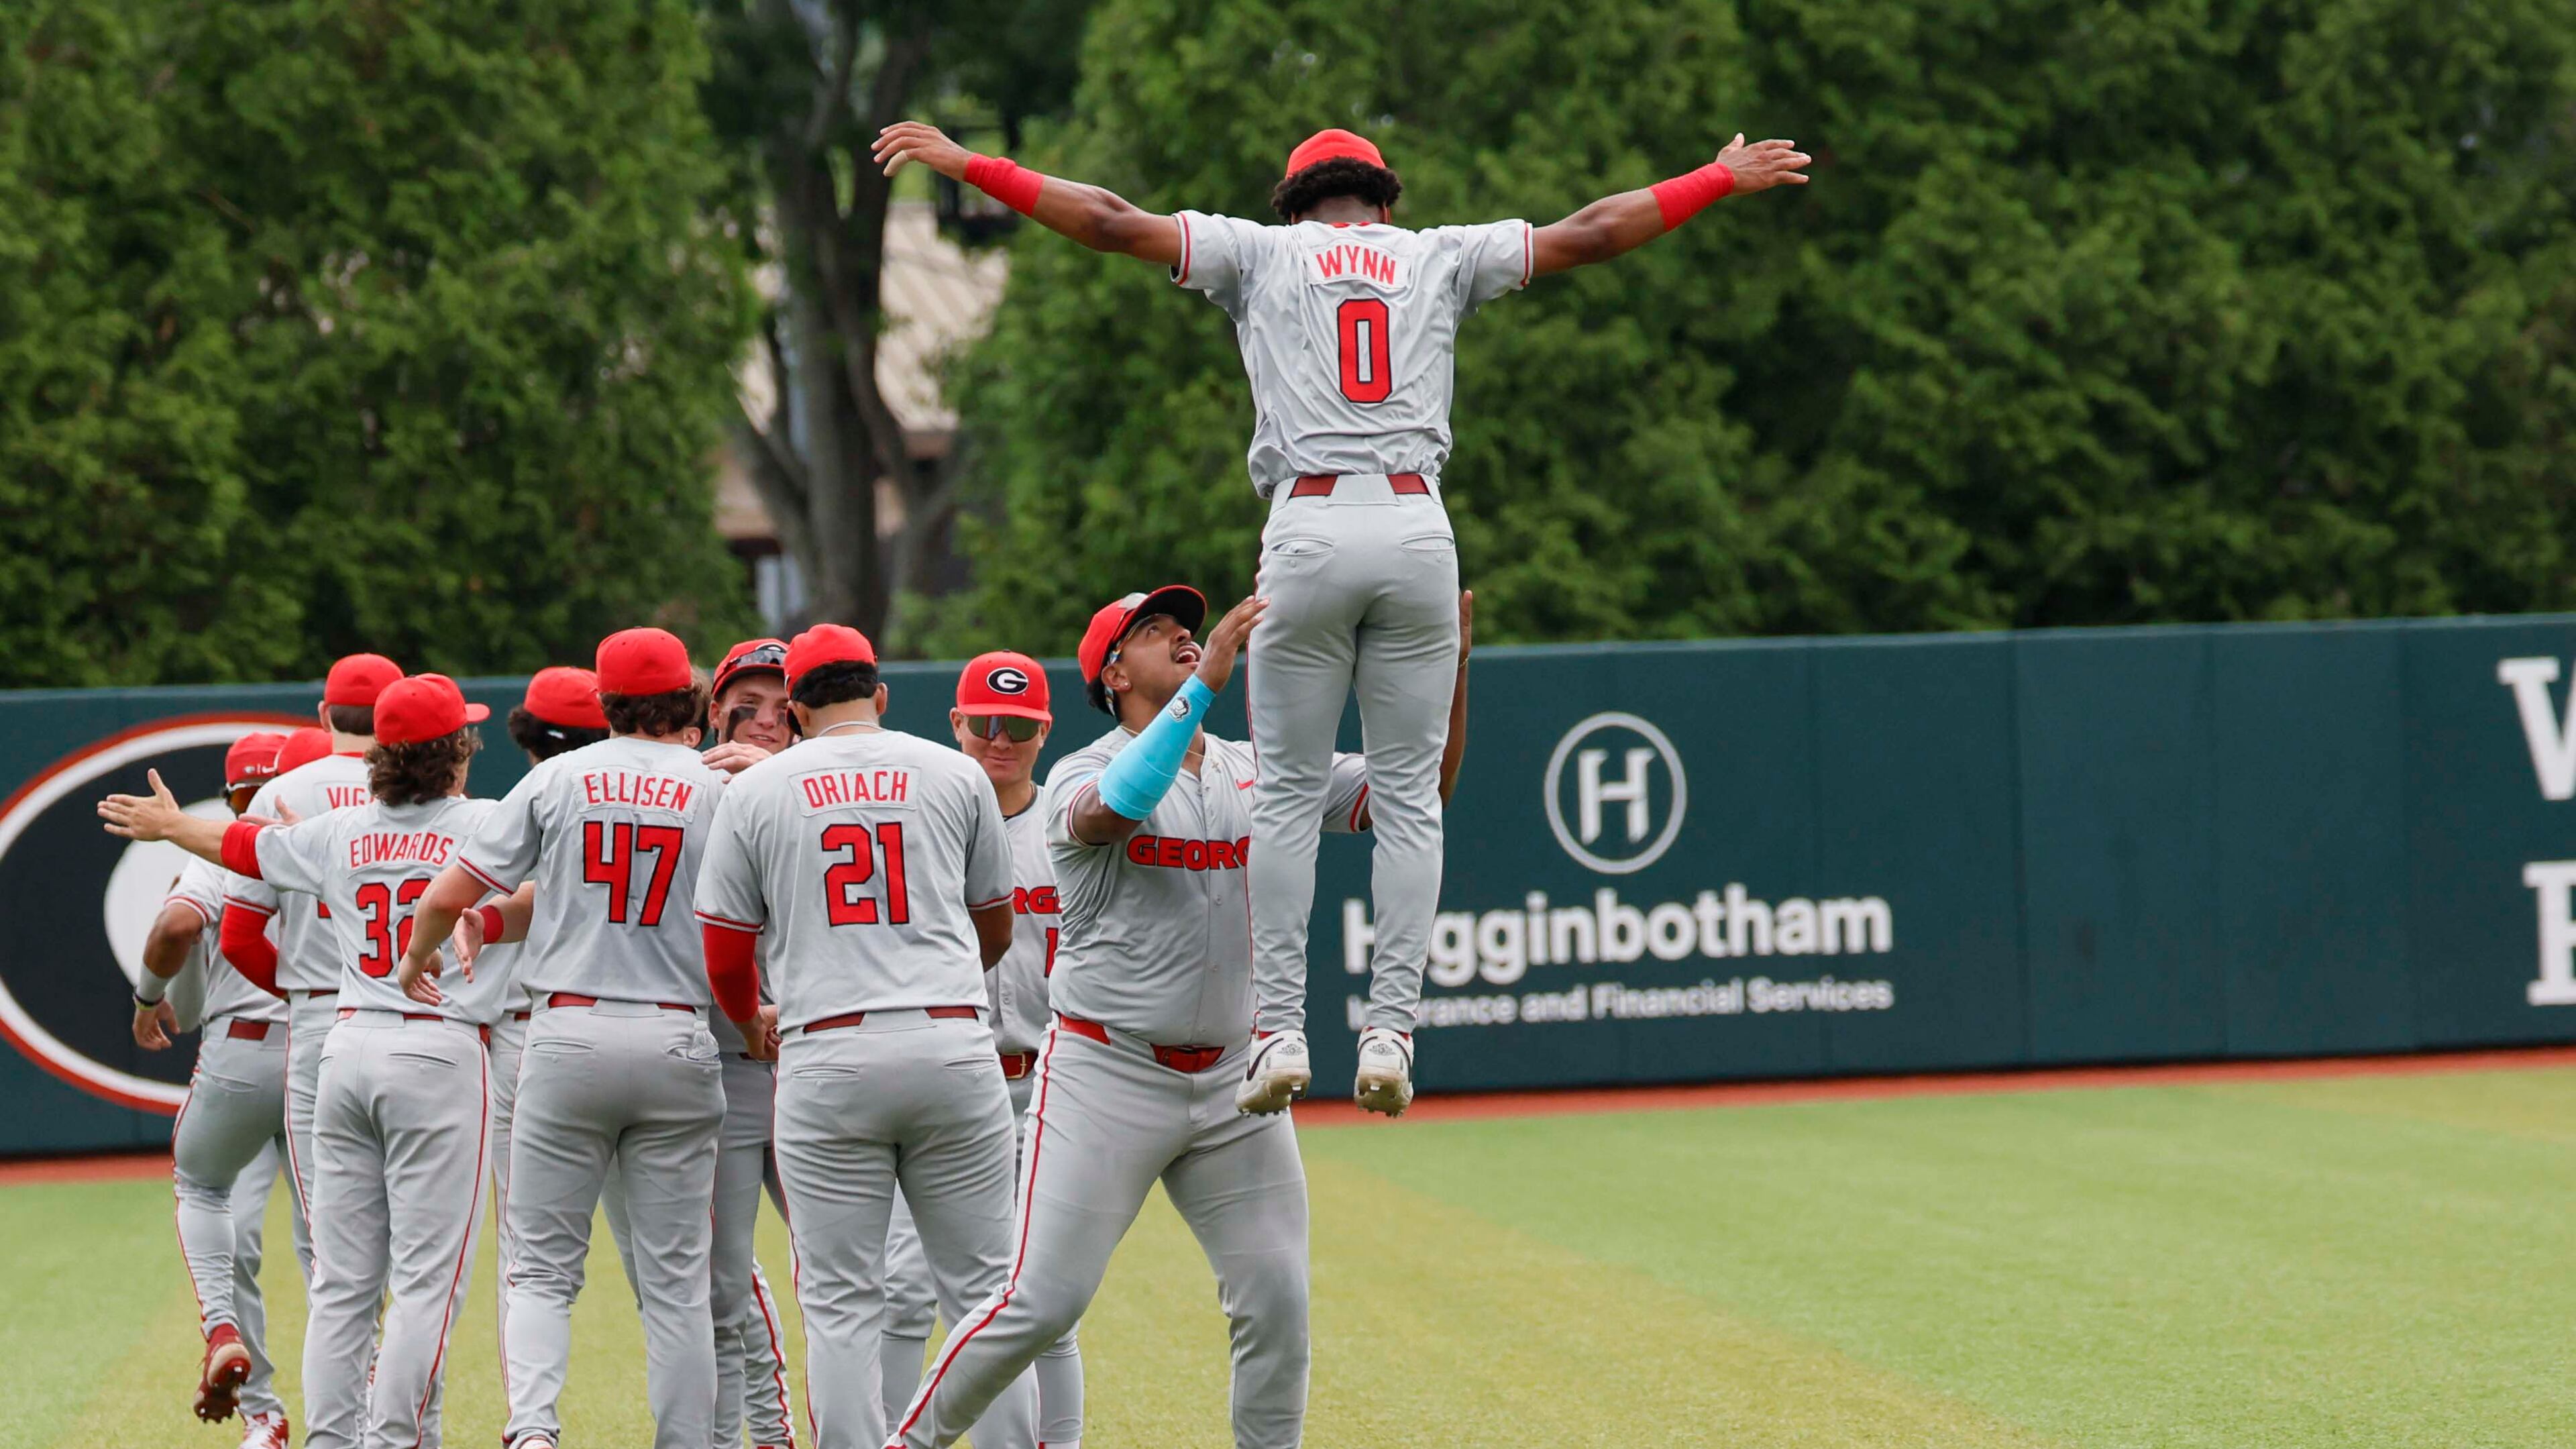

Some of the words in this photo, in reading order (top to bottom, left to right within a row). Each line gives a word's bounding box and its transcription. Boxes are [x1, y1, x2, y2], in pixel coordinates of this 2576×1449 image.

[1316, 245, 1396, 285] WYNN
[1337, 298, 1393, 403] 0
[583, 772, 693, 812] ELLISEN
[802, 771, 908, 808] ORIACH
[1578, 747, 1656, 846] H
[350, 832, 453, 869] EDWARDS
[583, 821, 684, 926] 47
[820, 821, 910, 927] 21
[1343, 882, 1892, 987] Hgginbotham
[1347, 994, 1517, 1032] Irance
[1520, 984, 1589, 1022] and
[1591, 977, 1743, 1019] Financial
[1746, 975, 1894, 1014] Services
